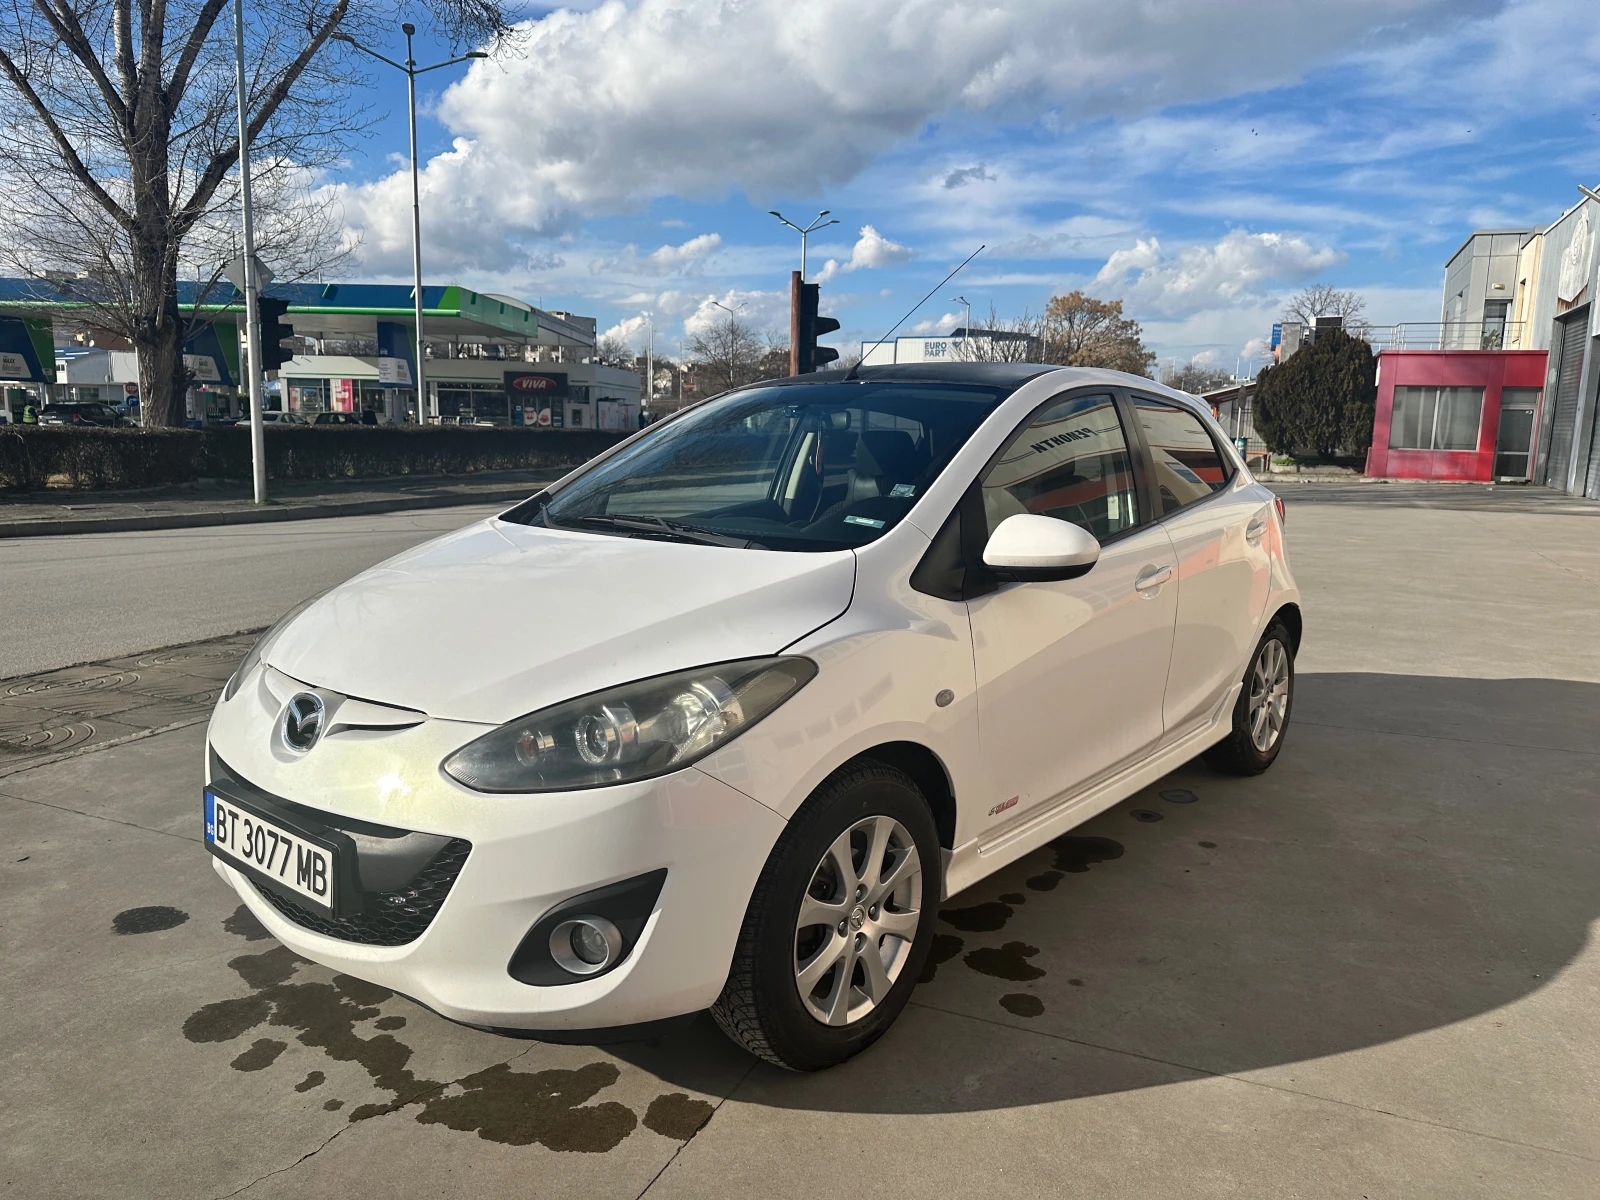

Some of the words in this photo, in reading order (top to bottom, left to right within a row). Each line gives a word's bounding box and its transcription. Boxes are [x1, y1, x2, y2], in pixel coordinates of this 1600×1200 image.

[924, 341, 947, 350] EURO
[924, 349, 947, 357] PART
[522, 379, 547, 389] VIVA
[206, 822, 214, 836] BG
[216, 802, 239, 850] BT
[242, 818, 293, 877] 3077
[296, 843, 327, 897] MB
